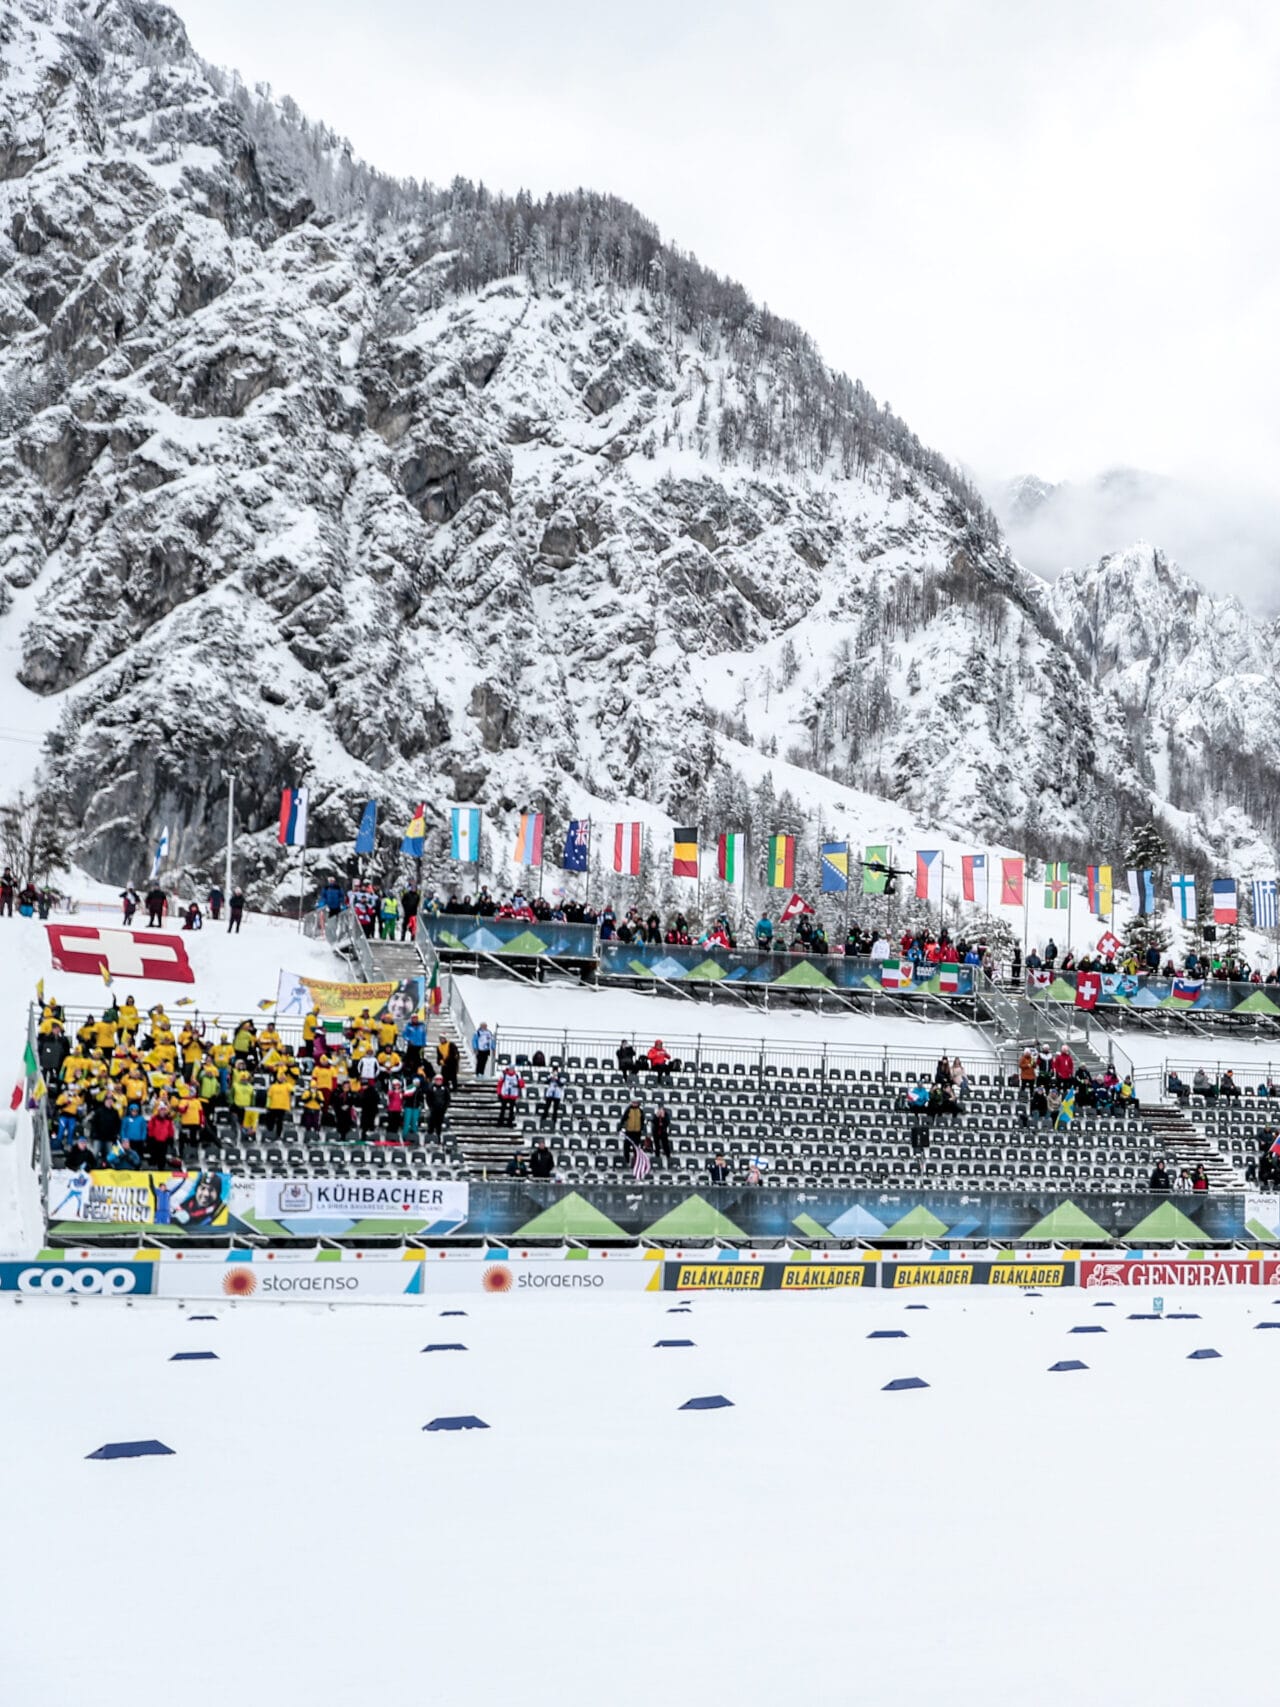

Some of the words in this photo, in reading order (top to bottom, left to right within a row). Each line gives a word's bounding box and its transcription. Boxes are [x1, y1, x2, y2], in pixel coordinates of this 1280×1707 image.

[317, 1185, 444, 1204] KÜHBACHER
[18, 1268, 136, 1296] coop
[262, 1275, 359, 1292] storaenso
[518, 1273, 604, 1288] storaenso
[682, 1267, 760, 1286] BLÅKLÄDER
[785, 1266, 861, 1286] BLÅKLÄDER
[898, 1266, 969, 1285] BLÅKLÄDER
[993, 1265, 1061, 1285] BLÅKLÄDER
[1128, 1263, 1253, 1285] GENERALI
